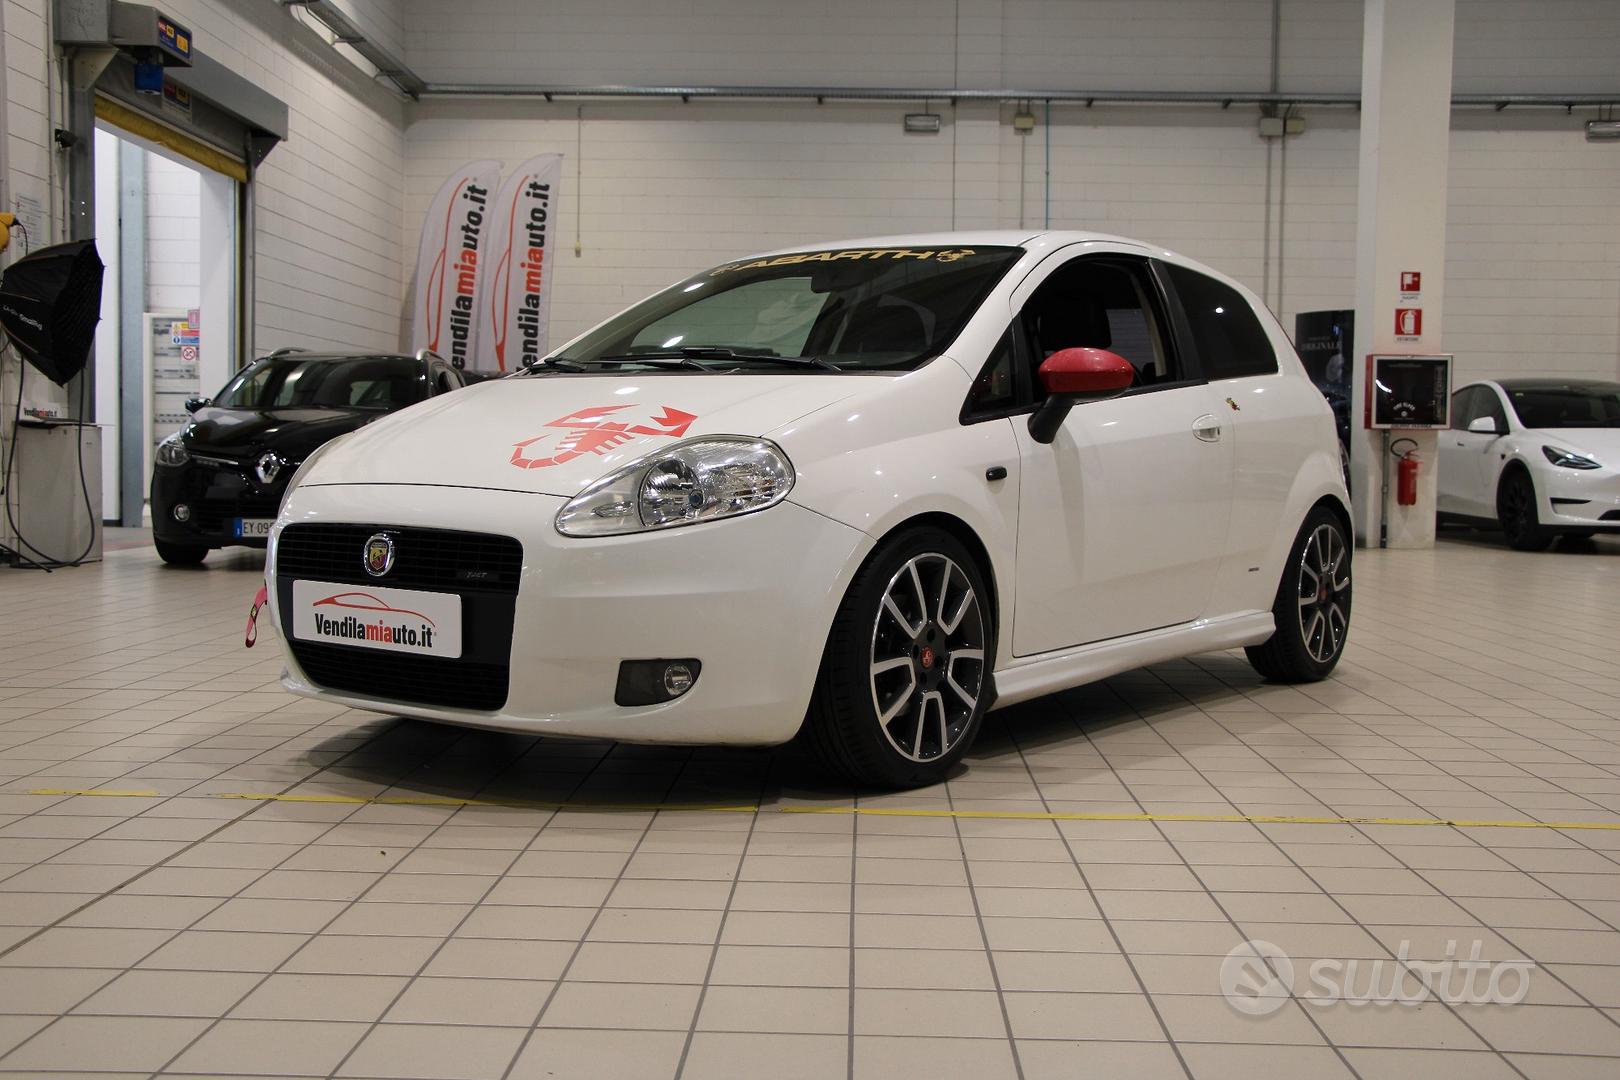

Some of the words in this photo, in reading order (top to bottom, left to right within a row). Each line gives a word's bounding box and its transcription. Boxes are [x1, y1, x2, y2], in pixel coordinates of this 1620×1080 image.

[451, 184, 487, 371] endilamiauto.it
[516, 181, 549, 372] endilamiauto.it
[736, 250, 933, 272] ABARTH
[243, 521, 254, 534] EY
[314, 613, 433, 648] Vendilamiauto.it
